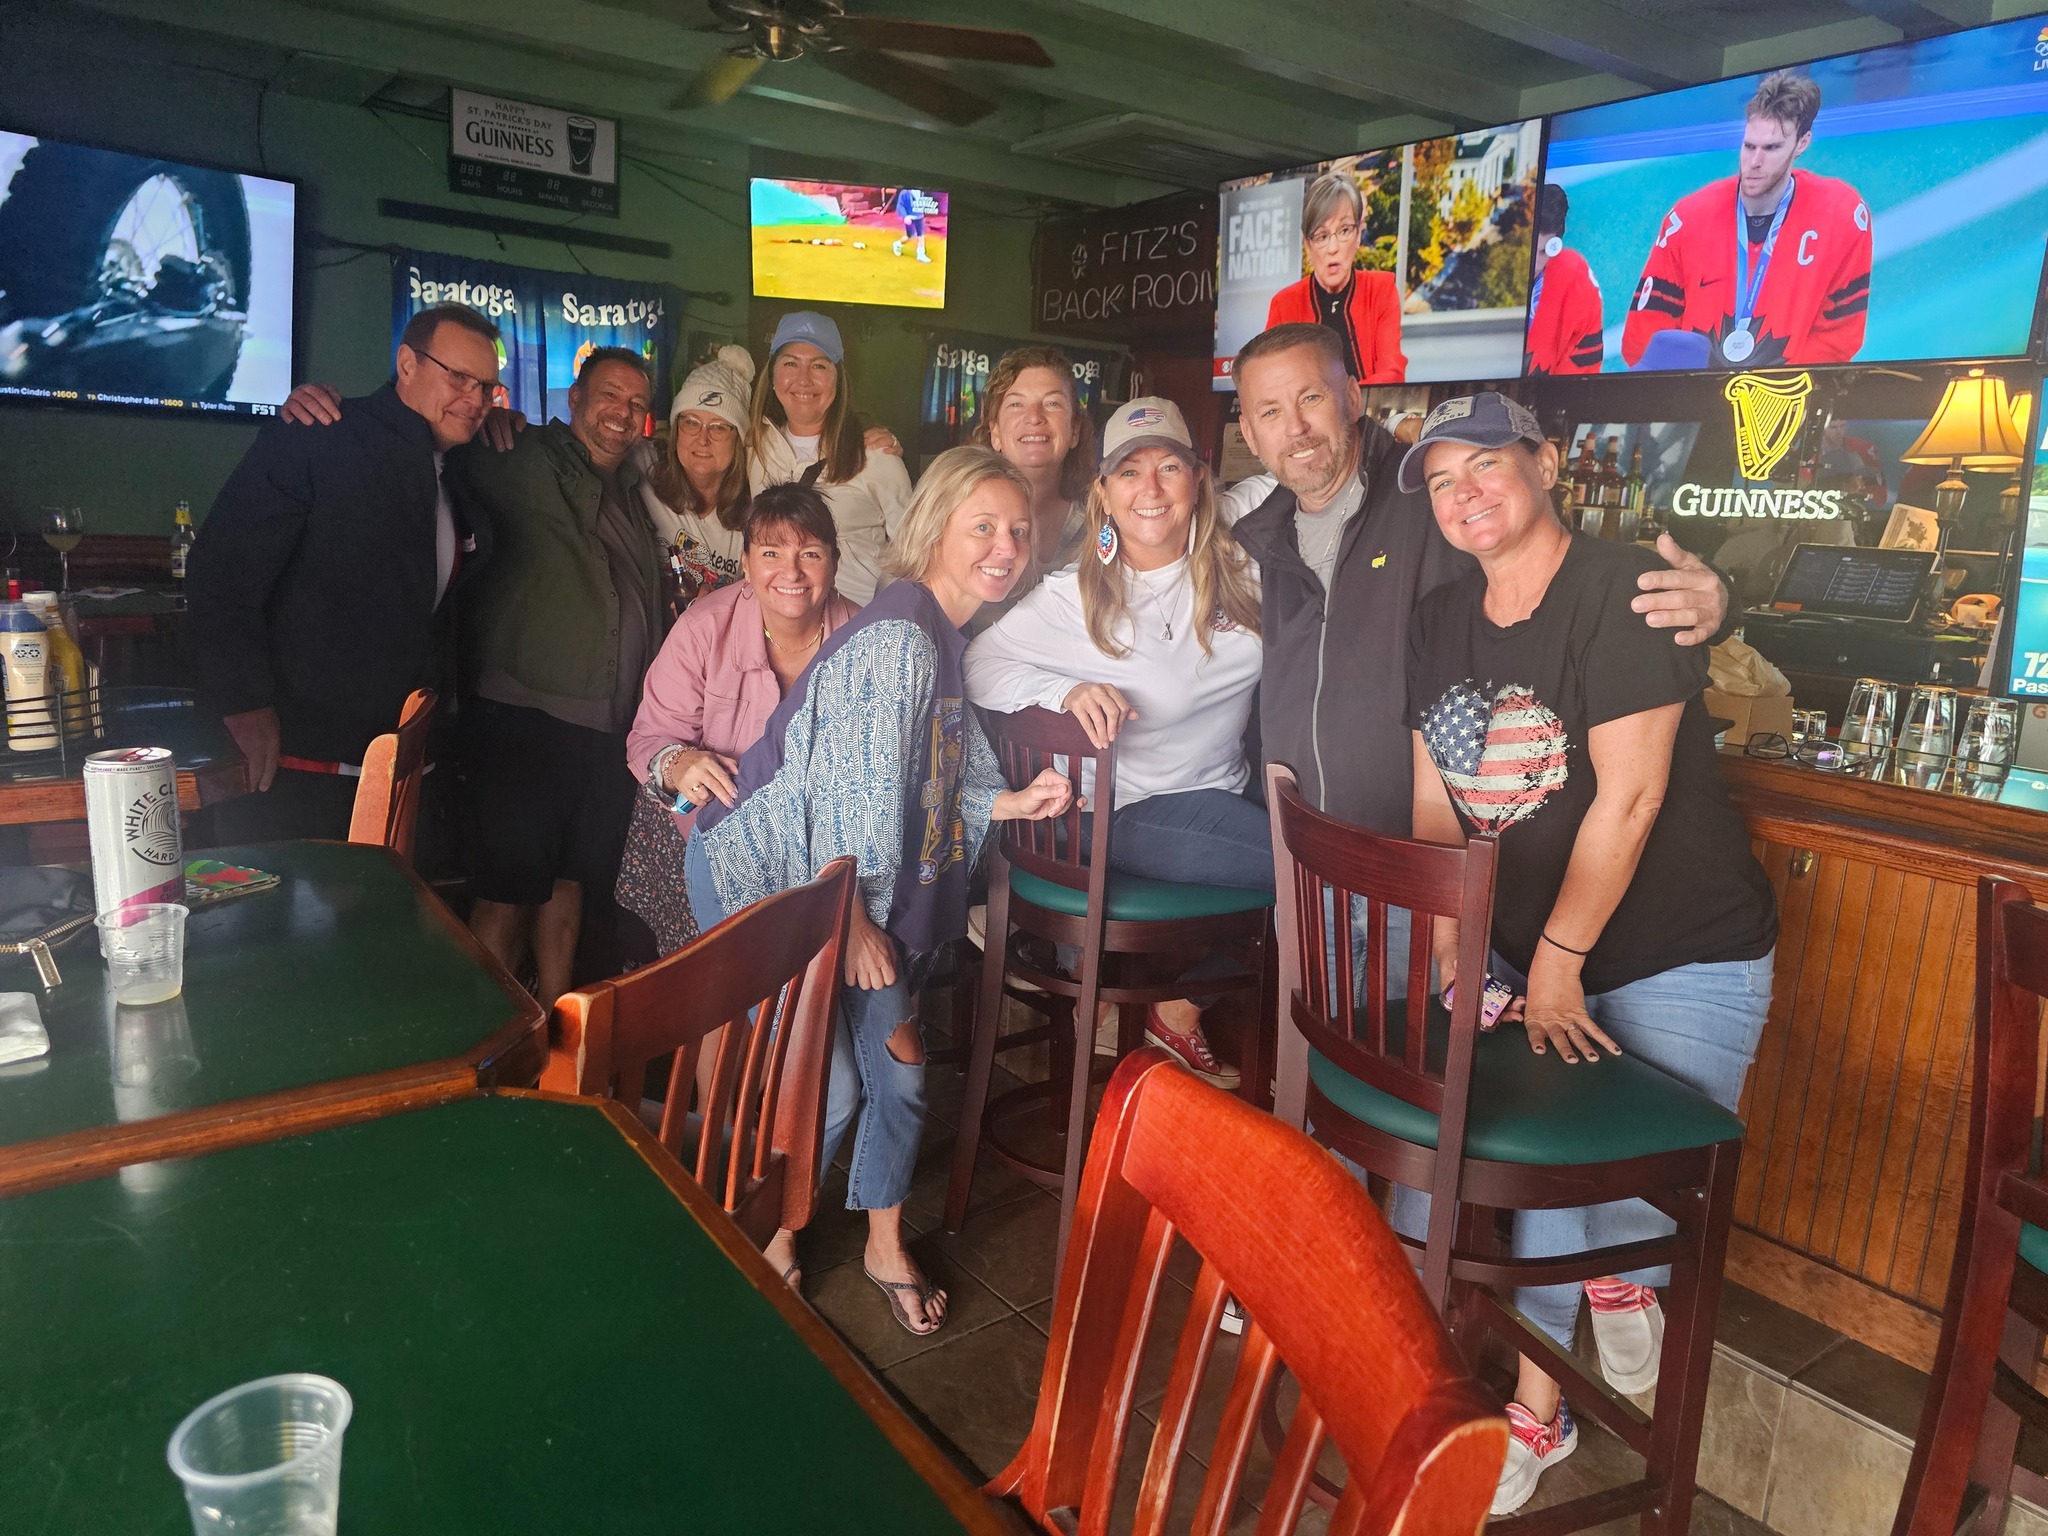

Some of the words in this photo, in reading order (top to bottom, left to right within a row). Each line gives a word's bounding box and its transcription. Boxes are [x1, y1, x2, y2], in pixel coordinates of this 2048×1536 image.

[467, 106, 481, 116] ST.
[484, 108, 531, 126] PATRICK'S
[533, 119, 553, 130] DAY
[495, 102, 527, 116] HAPPY
[466, 121, 554, 158] GUINNESS
[461, 178, 481, 189] DAYS
[497, 185, 523, 197] HOURS
[538, 192, 569, 204] MINUTES
[581, 199, 614, 211] SECONDS
[1101, 220, 1198, 266] FITZ'S
[1229, 208, 1284, 254] FACE
[1797, 230, 1818, 266] C
[1228, 247, 1290, 280] NATION
[410, 266, 518, 317] Saratoga
[1043, 283, 1125, 322] BACK
[20, 387, 51, 398] Cindric
[52, 390, 78, 400] +1600
[97, 393, 143, 405] Christopher
[143, 396, 159, 406] Bell
[160, 398, 184, 407] +1600
[200, 401, 218, 411] Tyler
[251, 404, 276, 417] FS1
[1672, 483, 1842, 520] GUINNESS
[710, 549, 739, 575] texas
[124, 791, 157, 842] WHITE
[158, 782, 174, 797] CL
[144, 847, 175, 861] HARD
